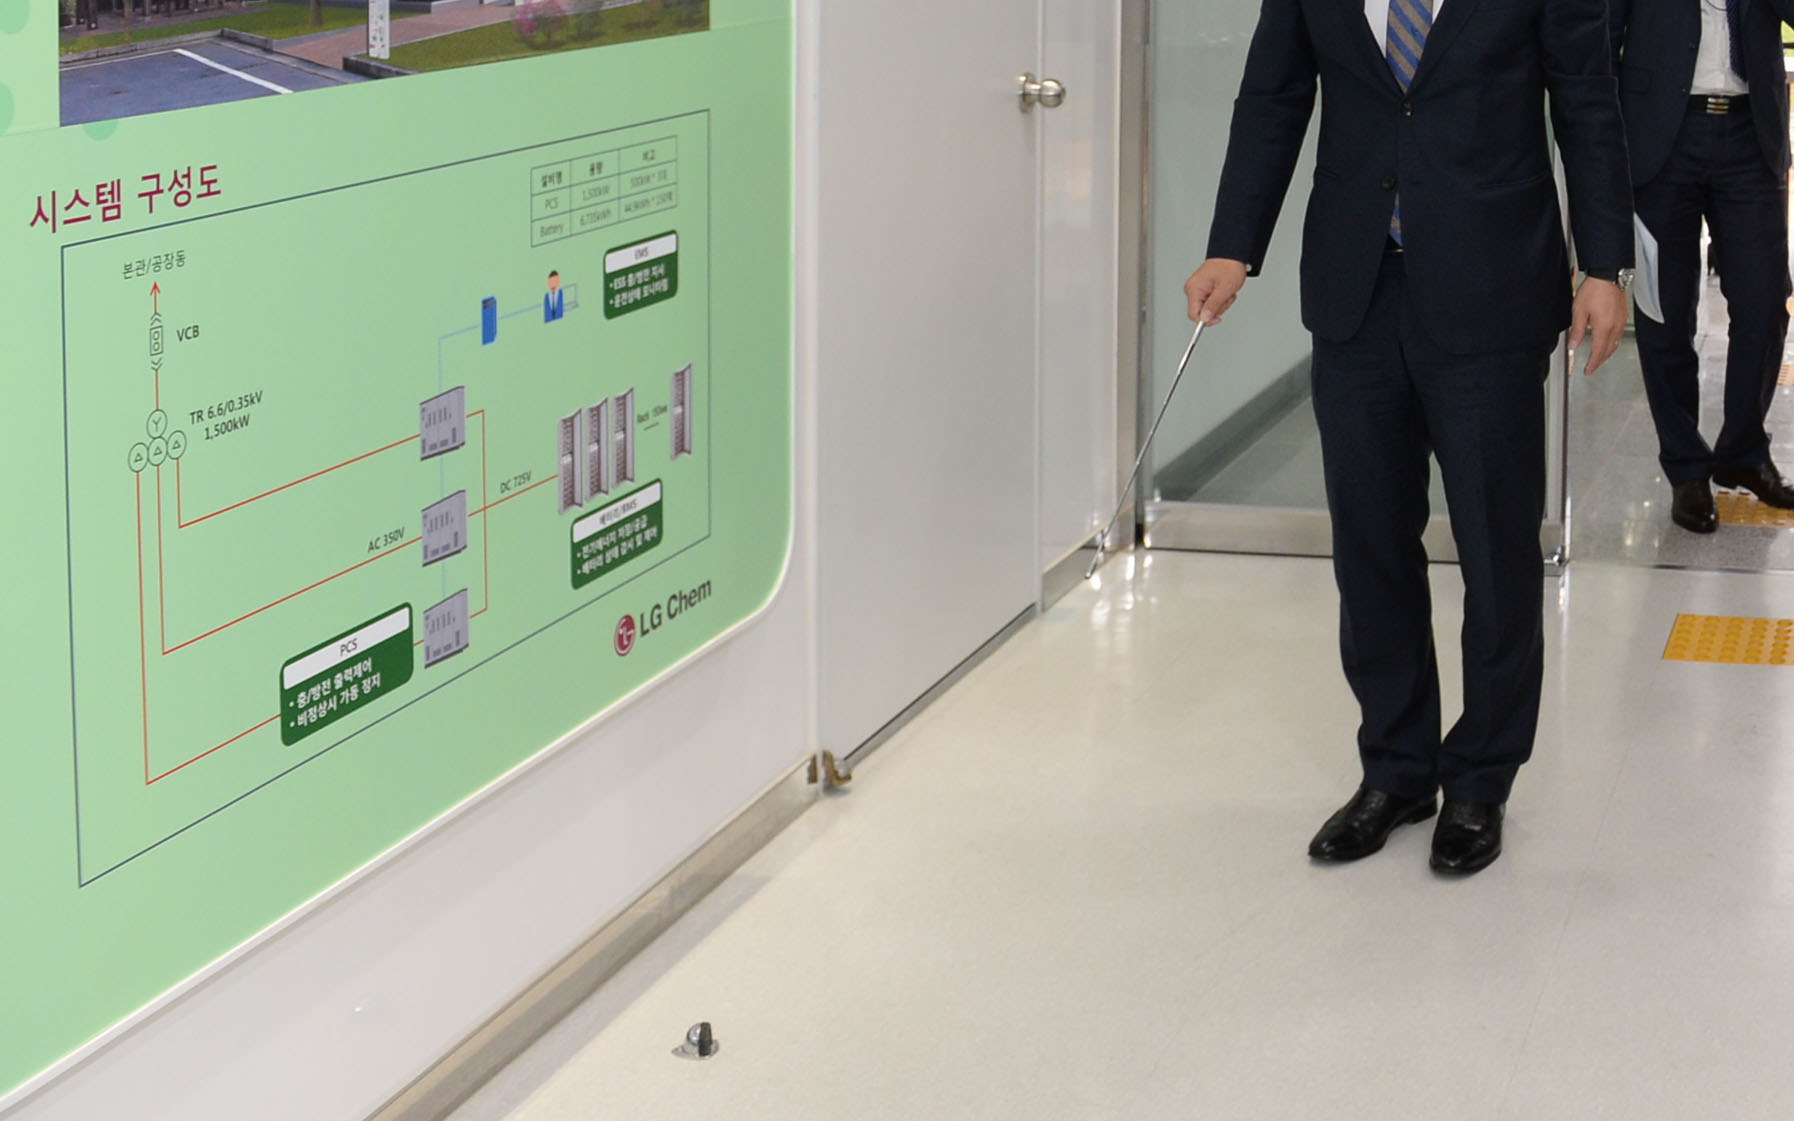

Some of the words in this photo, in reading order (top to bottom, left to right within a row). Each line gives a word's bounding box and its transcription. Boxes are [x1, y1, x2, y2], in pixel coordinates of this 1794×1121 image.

[29, 179, 122, 233] 시스템
[137, 164, 222, 213] 구성도
[540, 224, 564, 238] Battery
[122, 250, 186, 280] 본관/공장동
[176, 325, 200, 343] VCB
[190, 410, 204, 426] TR
[207, 390, 263, 420] 6.6/0.35kV
[203, 414, 251, 441] 1,500kW
[500, 480, 513, 494] DC
[514, 471, 532, 487] 725V
[368, 539, 381, 554] AC
[383, 527, 405, 547] 350V
[640, 603, 662, 638] LG
[667, 580, 711, 620] Chem
[340, 638, 358, 657] PCS
[297, 679, 331, 709] 충/방전
[297, 694, 337, 727] 비정상시
[339, 685, 359, 705] 가동
[362, 673, 381, 694] 정지
